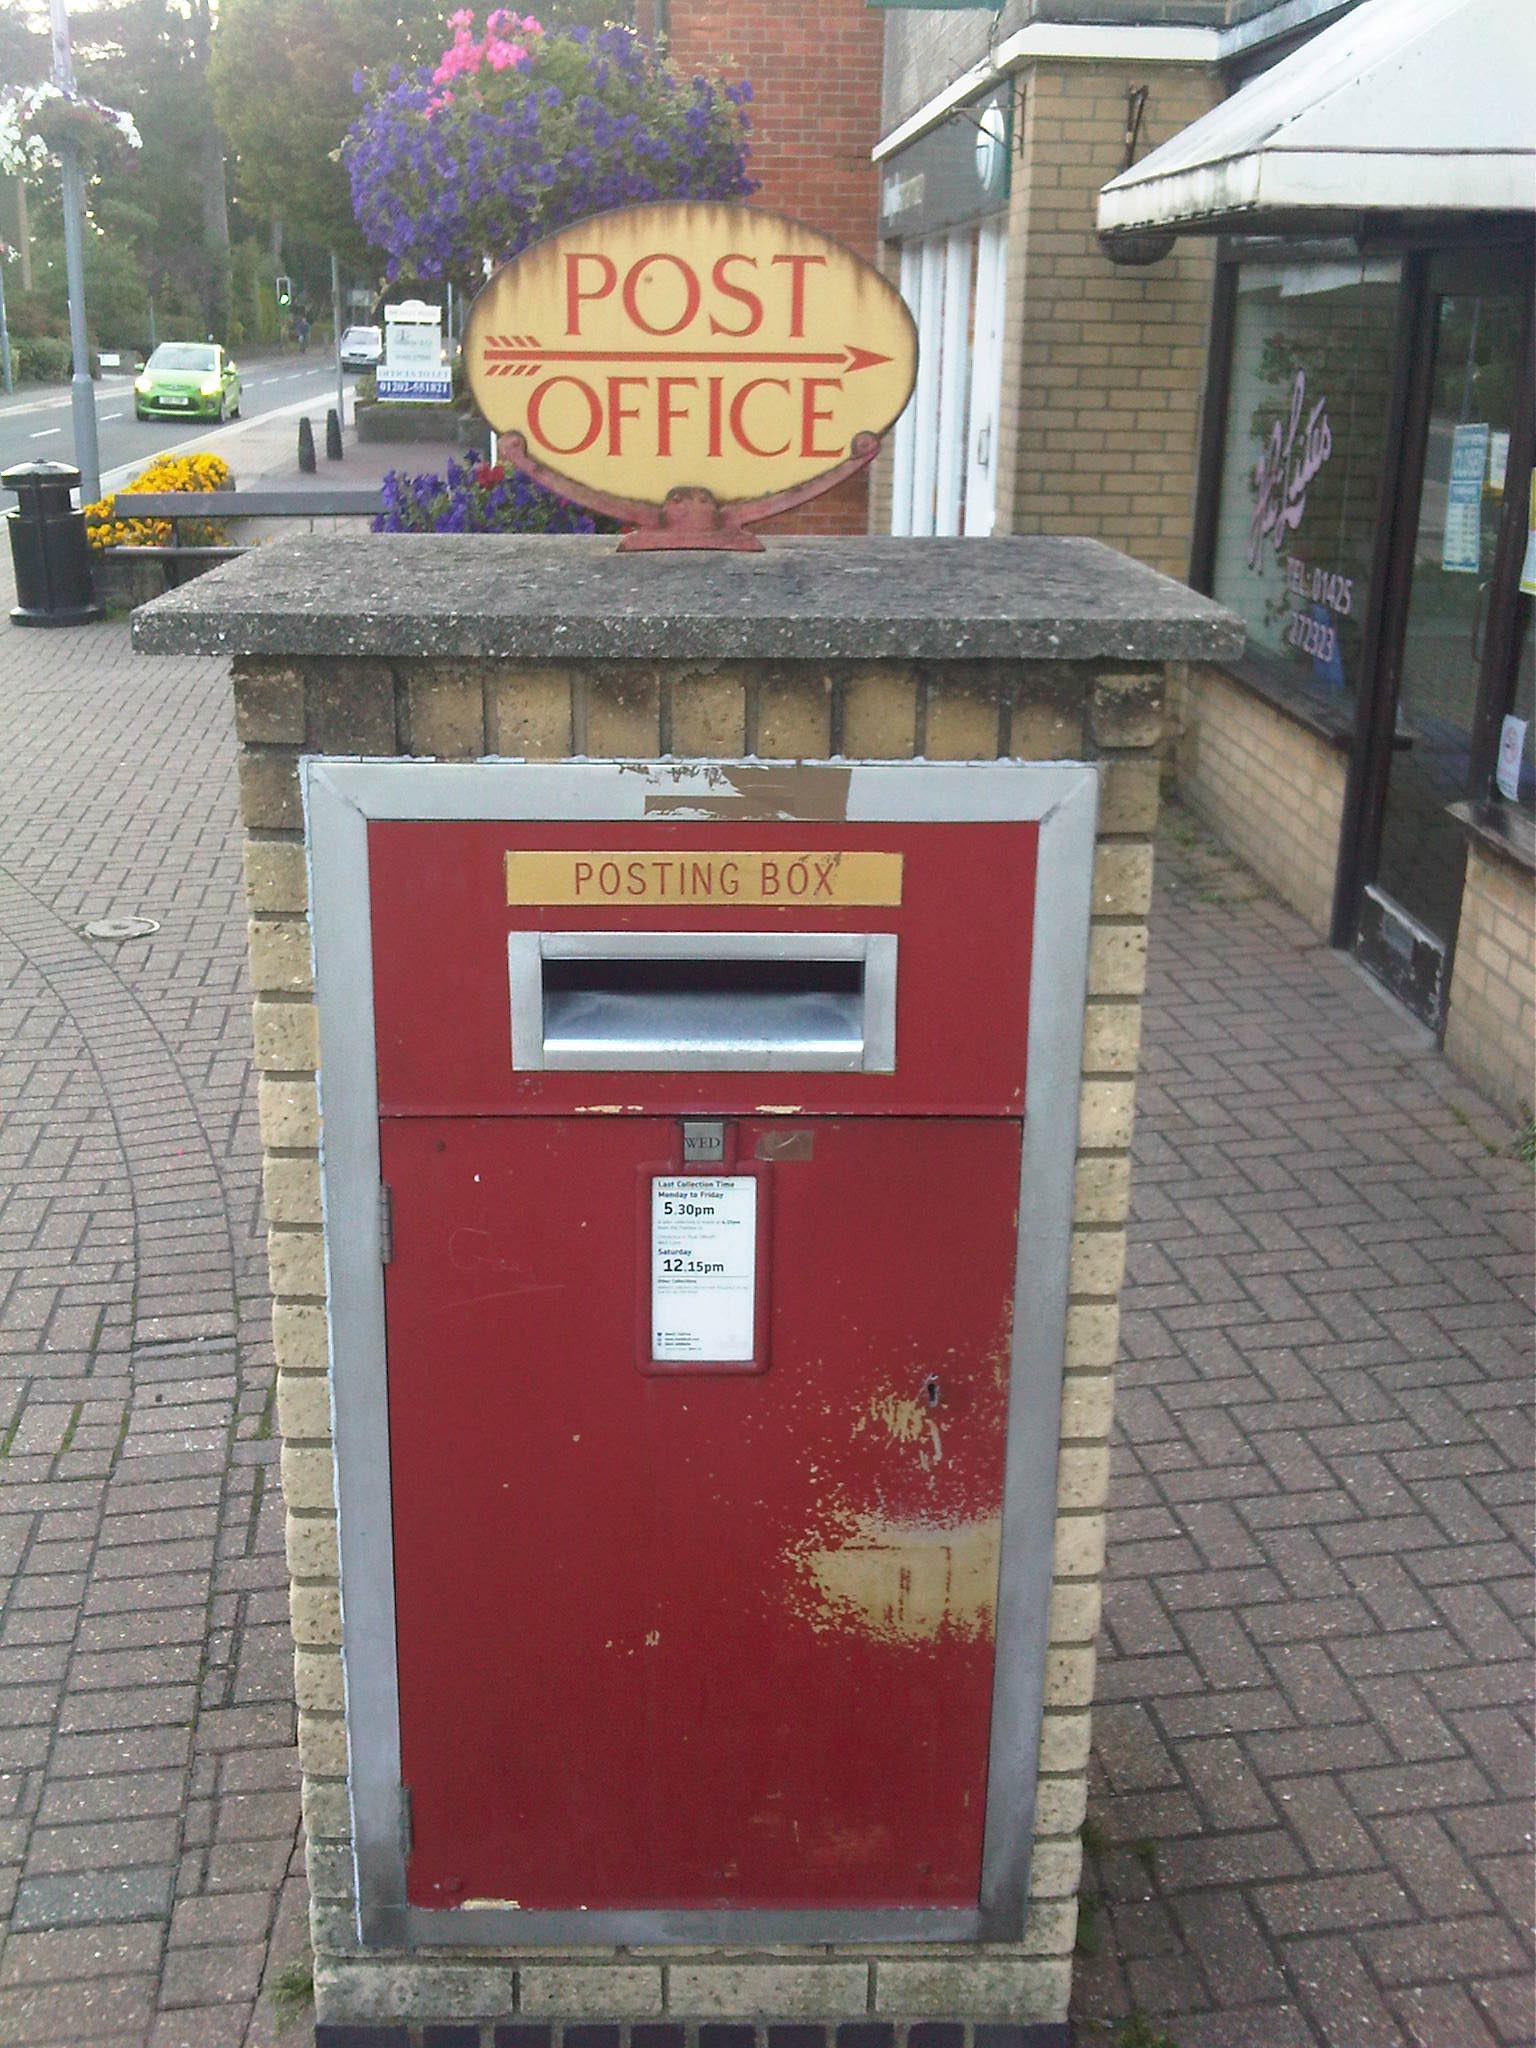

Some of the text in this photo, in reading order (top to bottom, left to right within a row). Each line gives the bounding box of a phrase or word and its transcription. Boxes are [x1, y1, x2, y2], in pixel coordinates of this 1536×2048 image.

[563, 252, 827, 338] POST
[526, 375, 845, 458] OFFICE
[1313, 568, 1351, 615] 01425
[574, 862, 835, 897] POSTING BOX
[685, 1137, 721, 1149] WED
[658, 1191, 688, 1199] Monday
[700, 1191, 724, 1199] Friday
[664, 1201, 715, 1217] 5.30pm
[658, 1248, 692, 1256] Saturday
[663, 1258, 724, 1274] 12.15pm
